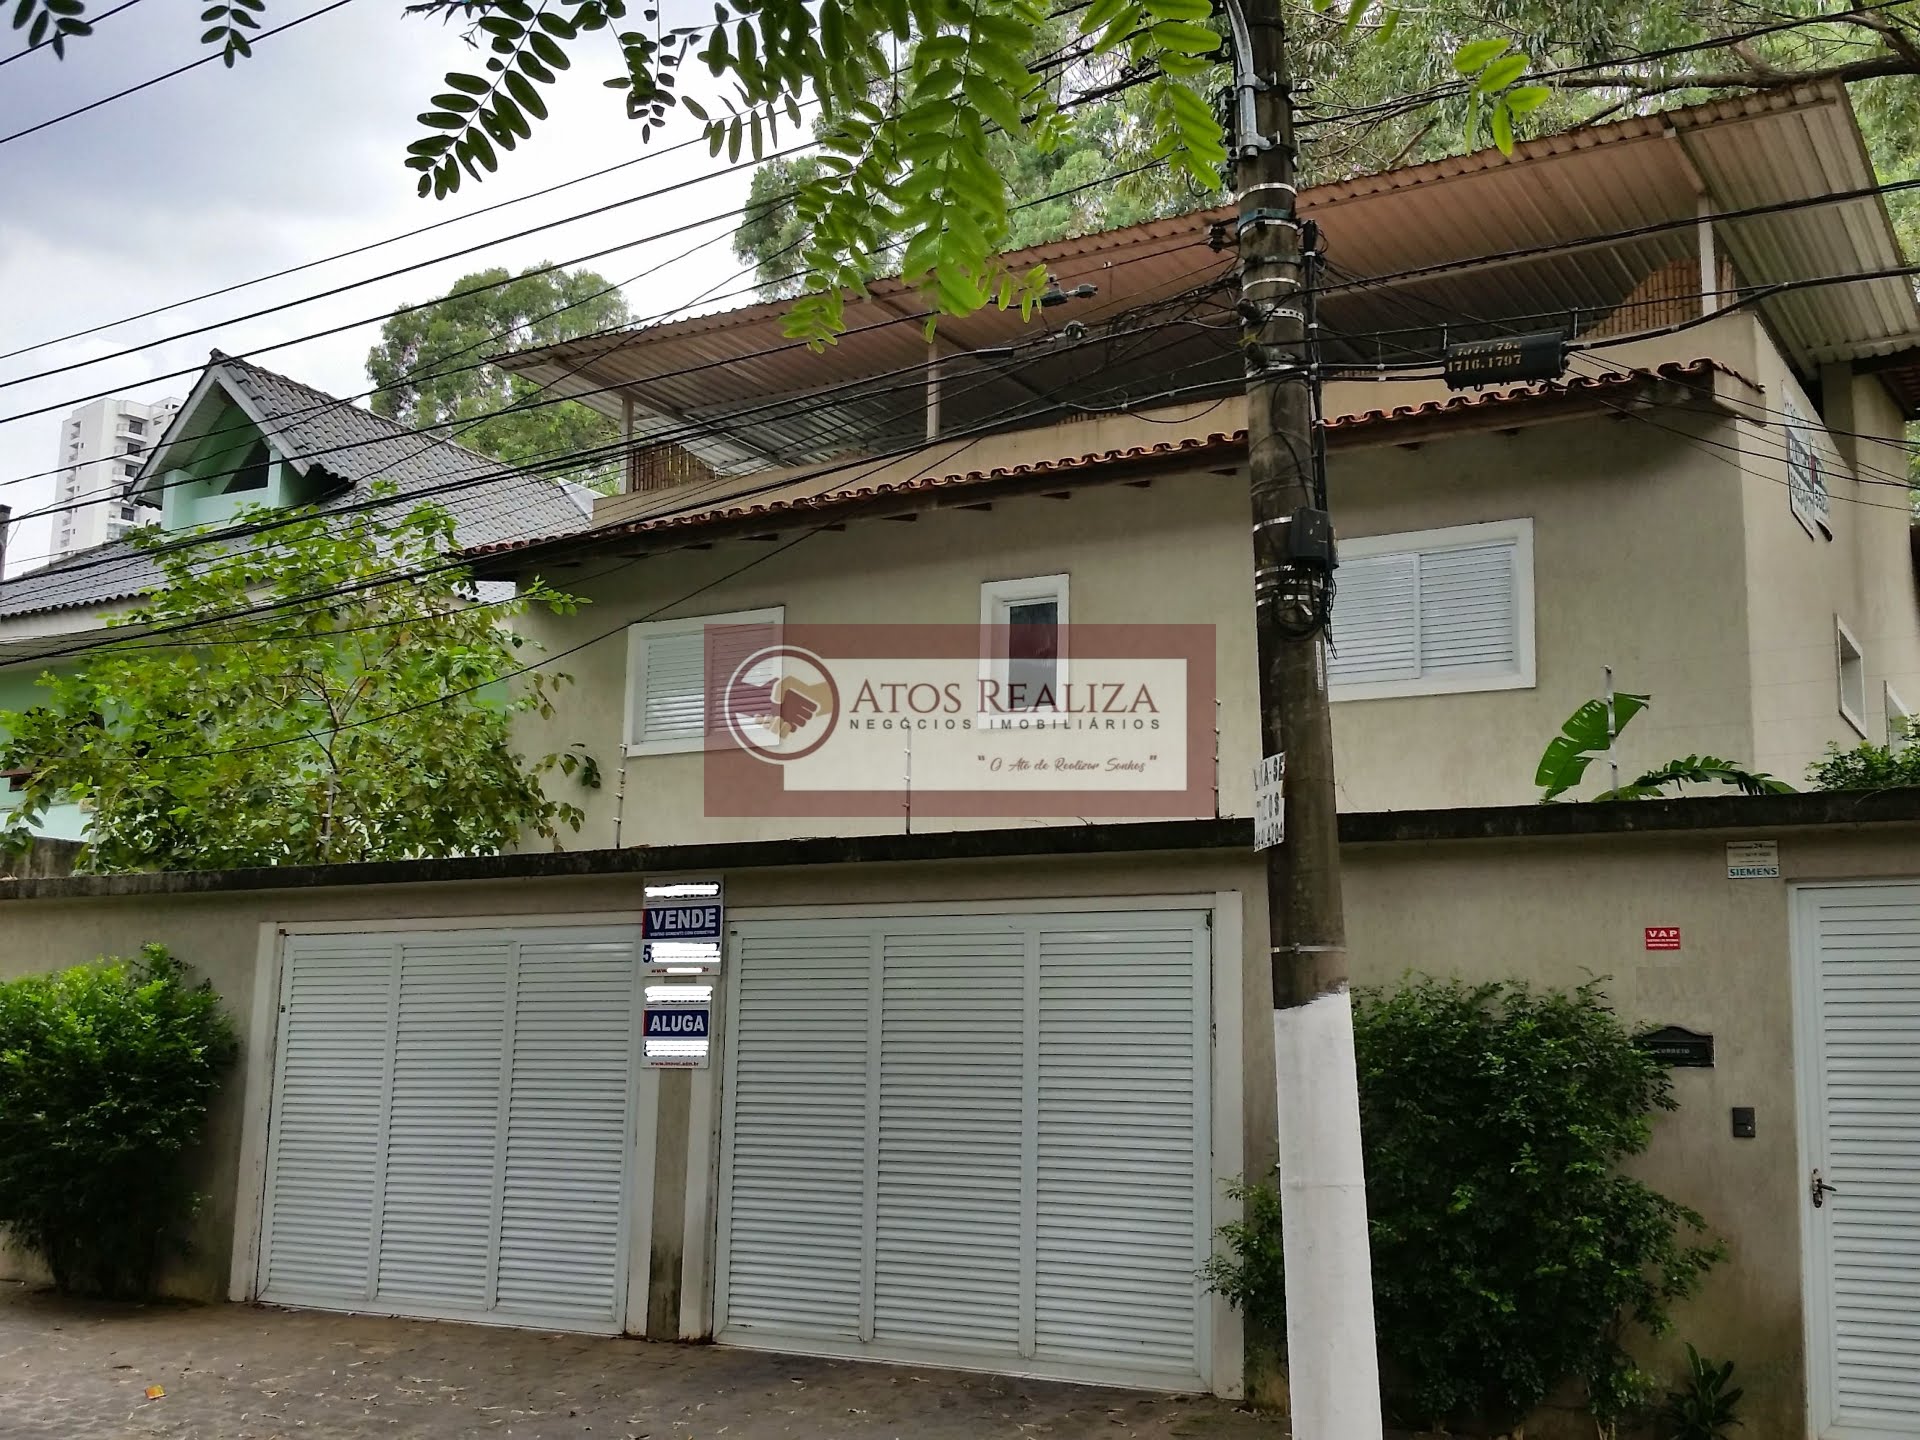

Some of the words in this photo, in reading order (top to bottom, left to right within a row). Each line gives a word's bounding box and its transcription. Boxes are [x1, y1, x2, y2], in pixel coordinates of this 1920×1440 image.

[1730, 868, 1777, 876] SIEMENS
[651, 908, 716, 930] VENDE
[650, 1015, 704, 1032] ALUGA
